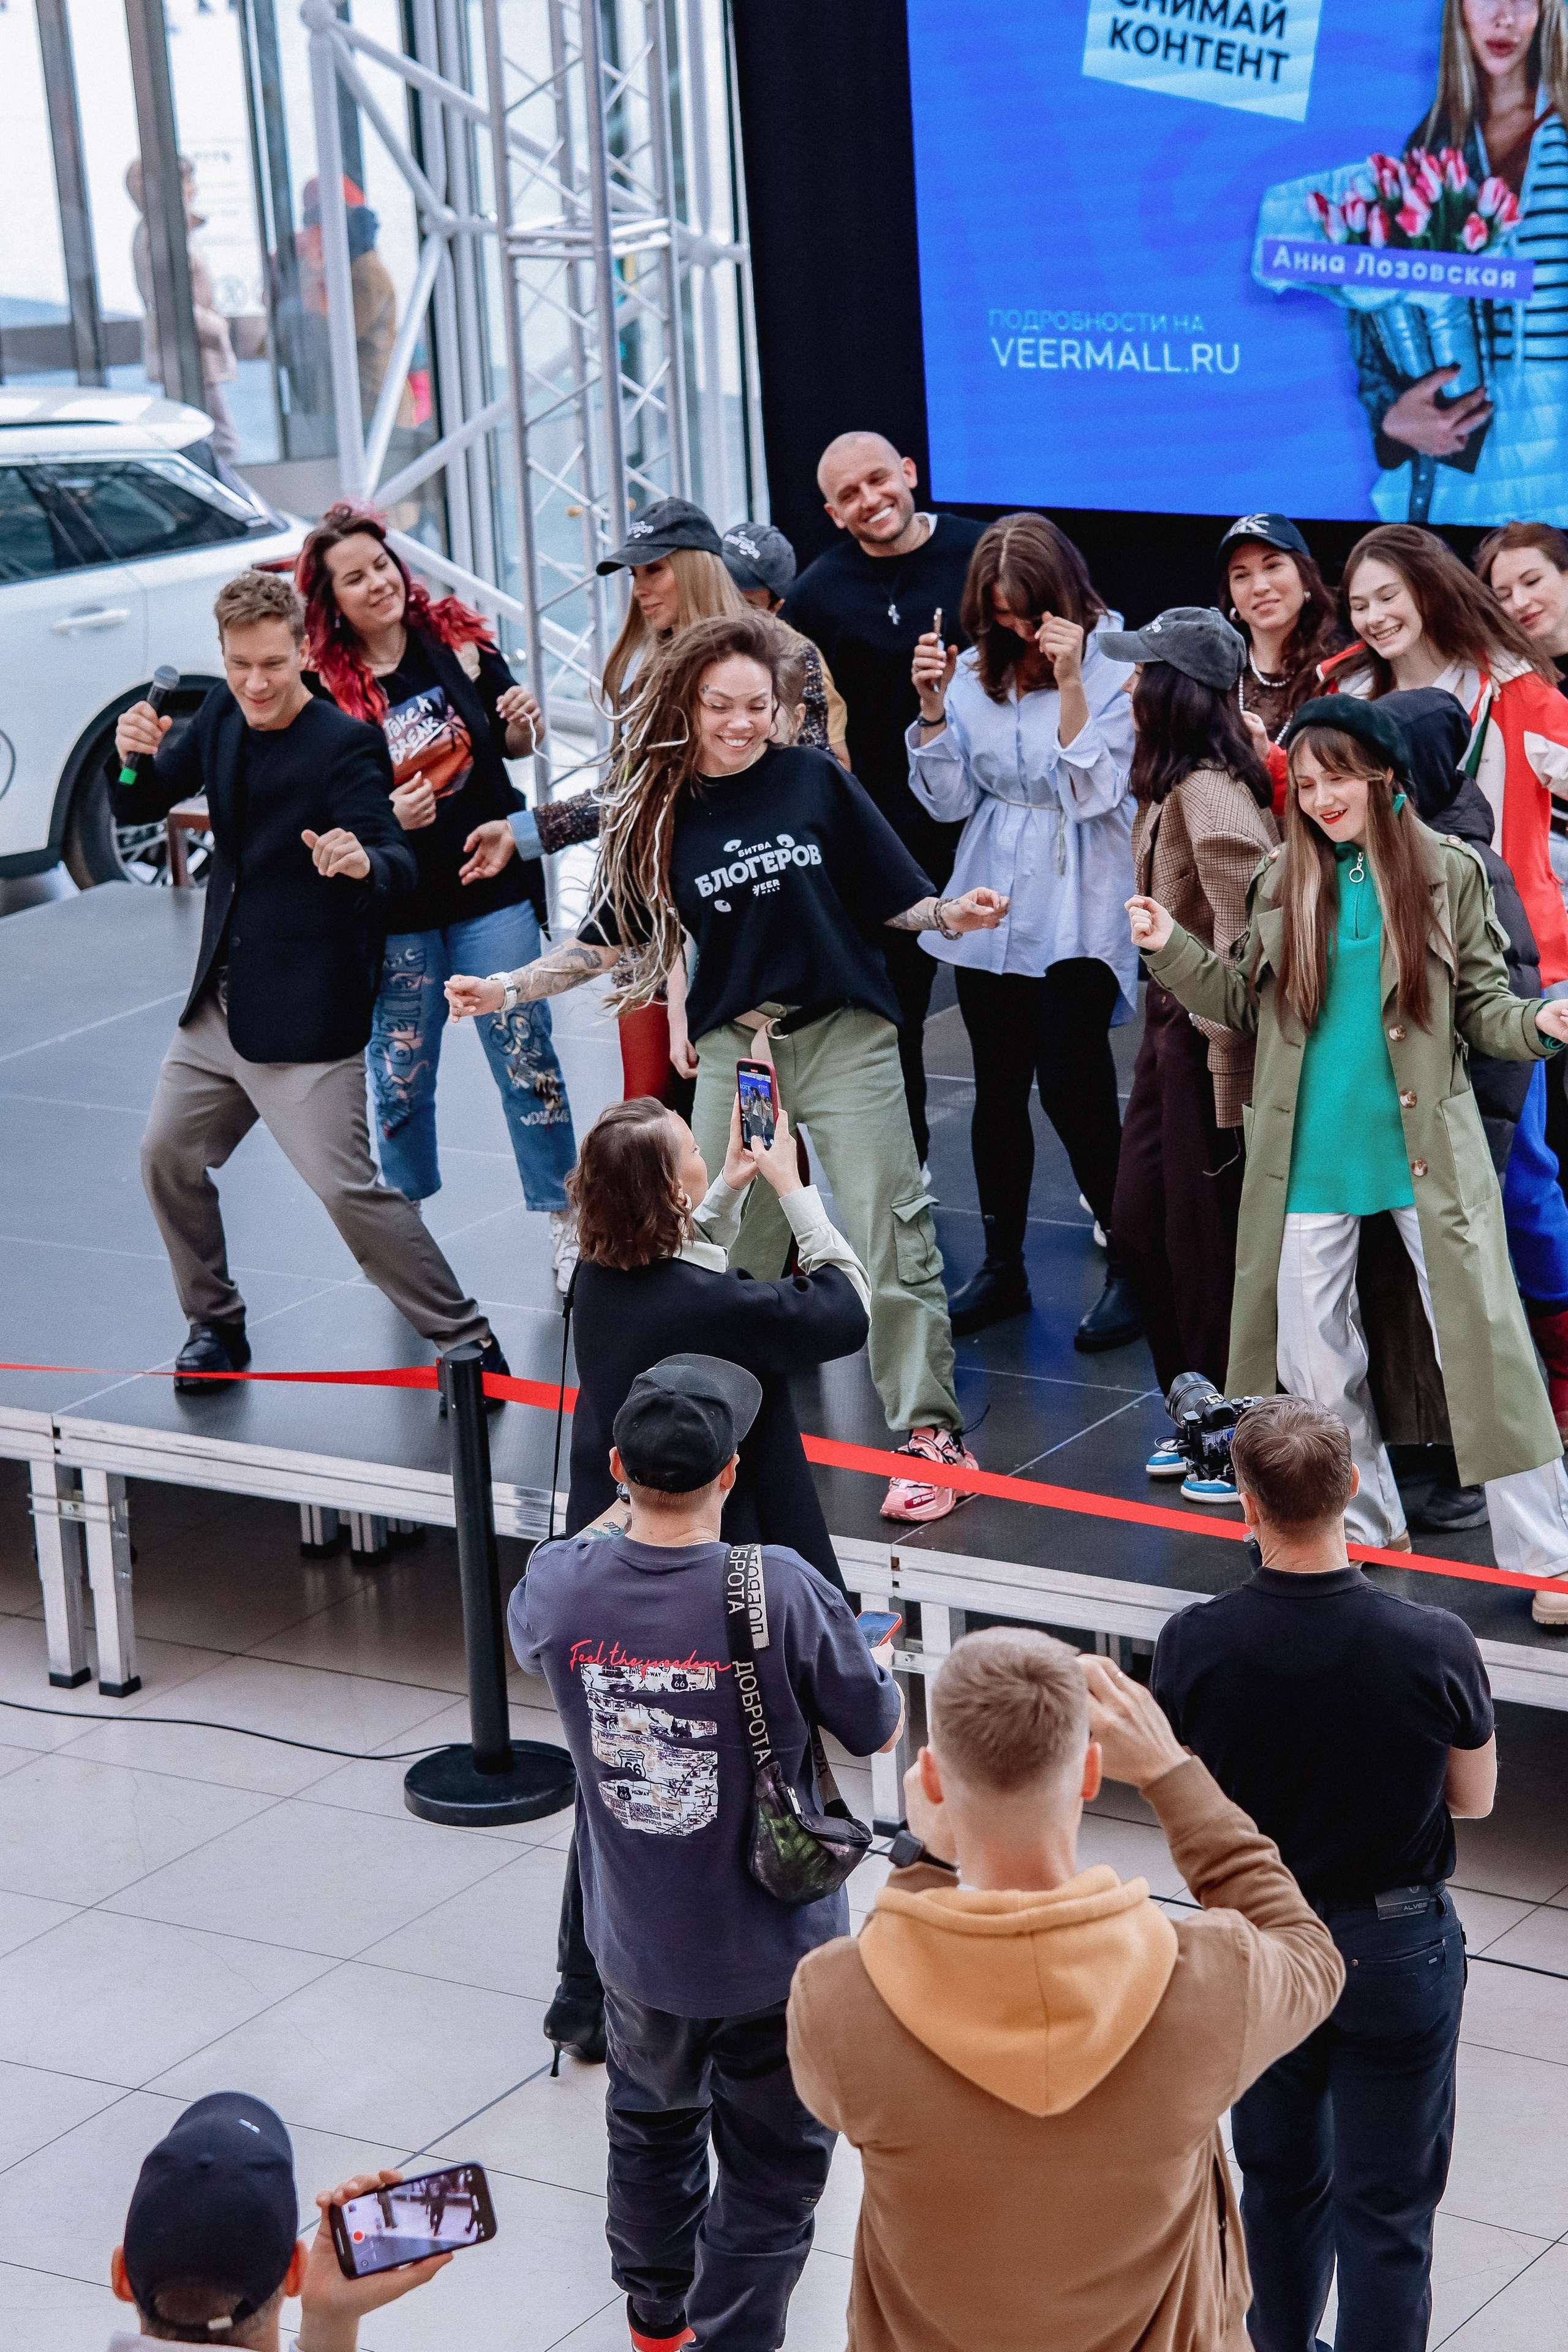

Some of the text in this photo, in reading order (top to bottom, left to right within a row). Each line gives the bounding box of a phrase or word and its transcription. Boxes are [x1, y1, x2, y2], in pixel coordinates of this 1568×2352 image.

[1109, 17, 1289, 83] КОНТЕНТ
[1273, 244, 1518, 289] Анна Лозовская
[988, 308, 1207, 334] ПОДРОБНОСТИ НА
[990, 336, 1240, 375] VEERMALL.RU
[694, 844, 822, 898] БЛОГЕРОВ
[737, 841, 772, 858] БИТВА
[727, 1545, 751, 1615] ОБРОТА
[732, 1660, 772, 1766] ДОБРОТА
